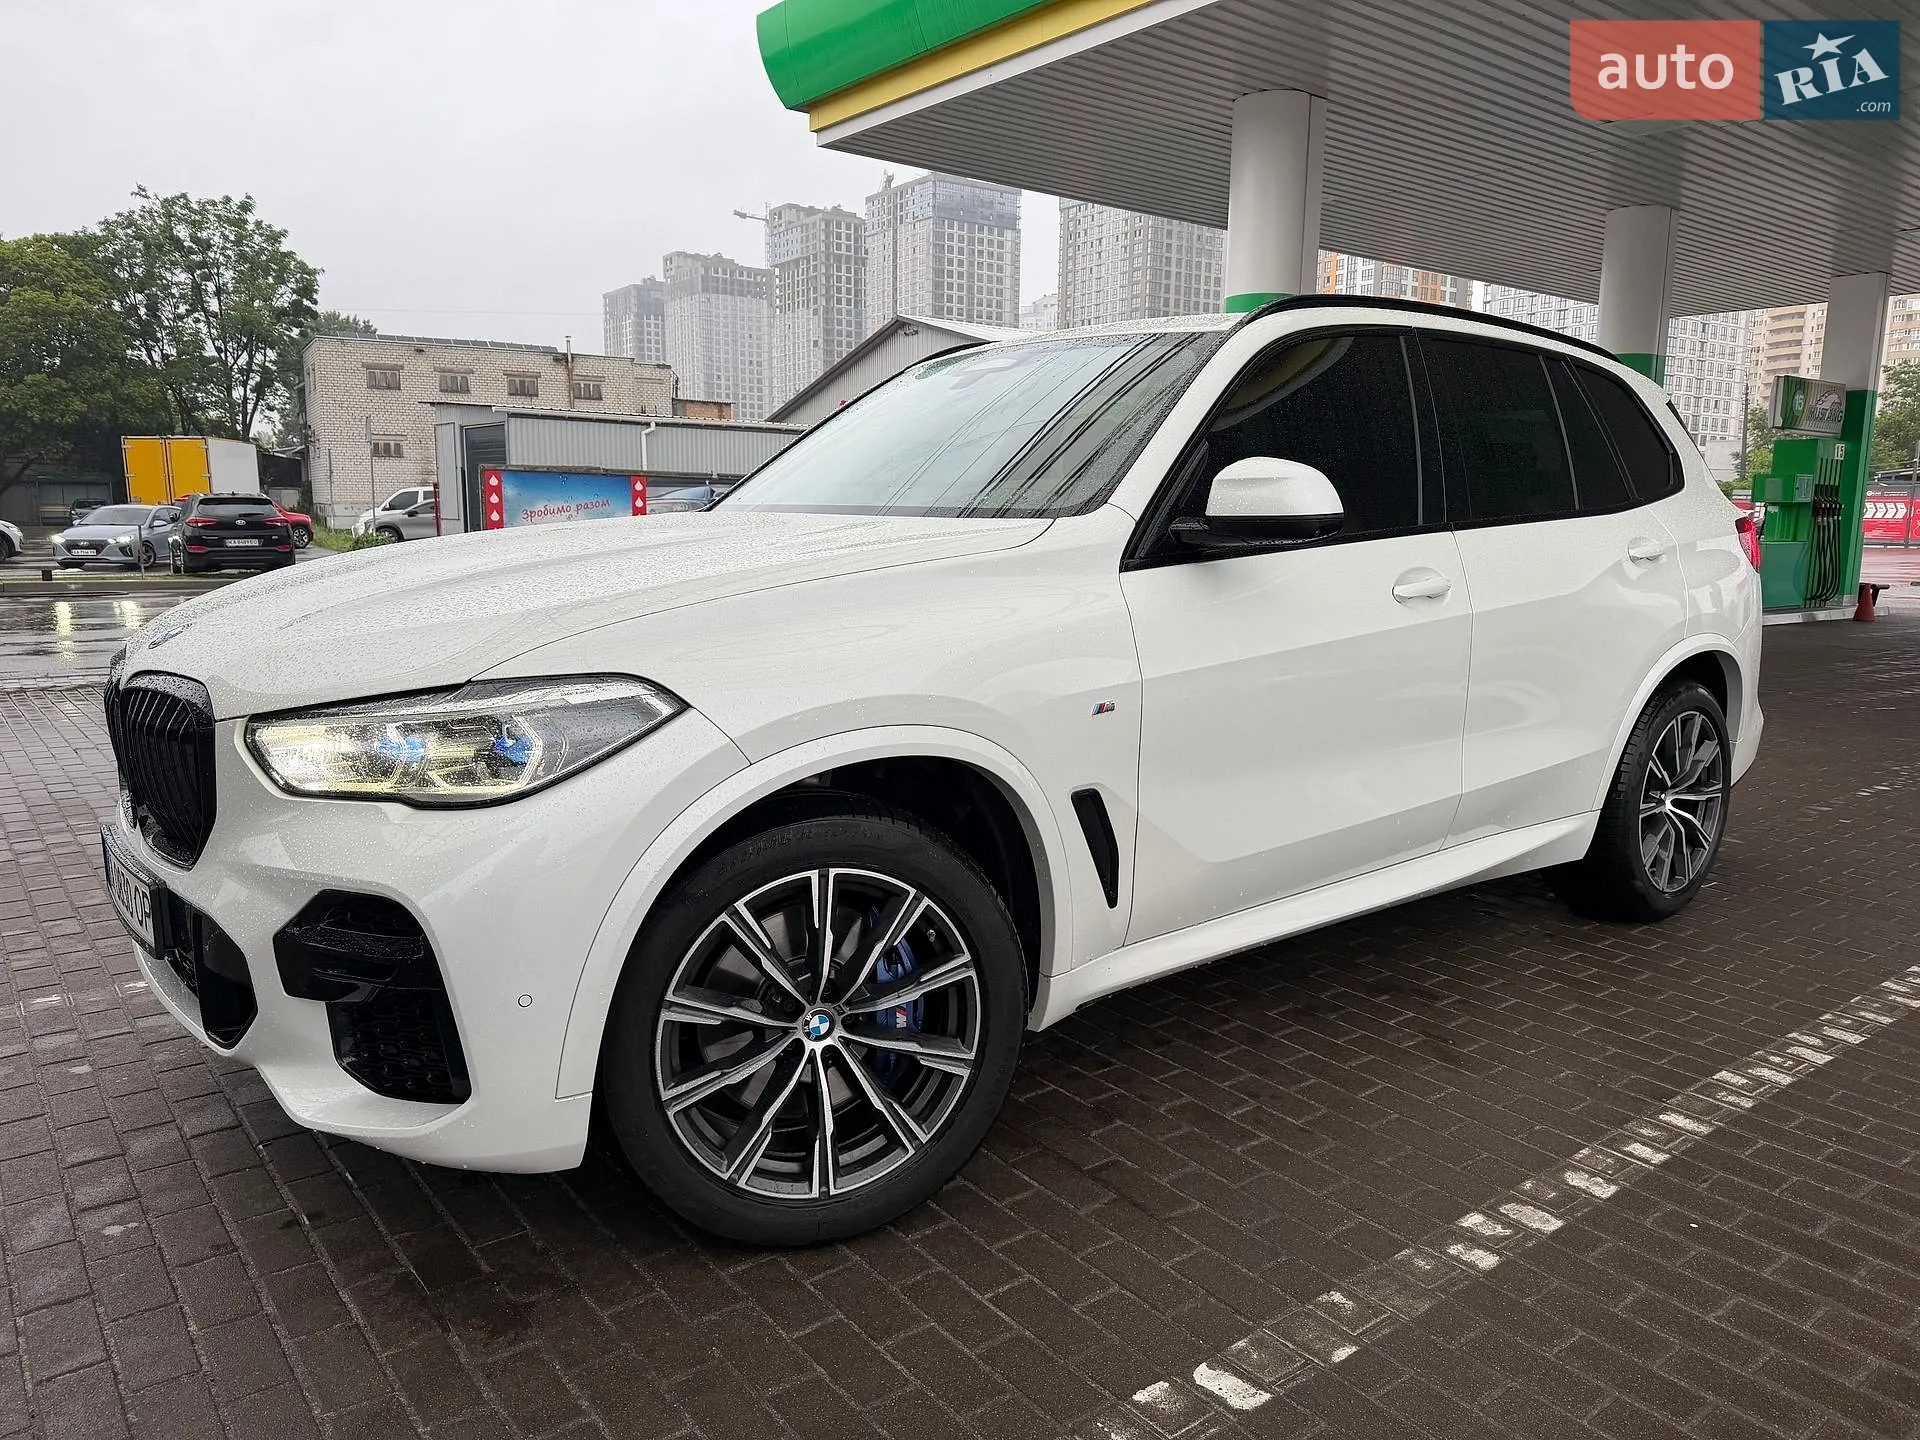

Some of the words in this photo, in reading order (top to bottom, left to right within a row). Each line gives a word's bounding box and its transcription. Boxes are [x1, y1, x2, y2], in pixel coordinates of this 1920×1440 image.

[1795, 395, 1805, 410] 15
[1809, 406, 1843, 423] MUSTANG
[1836, 445, 1844, 457] 15
[522, 504, 572, 522] Зробимо
[575, 499, 610, 514] разом
